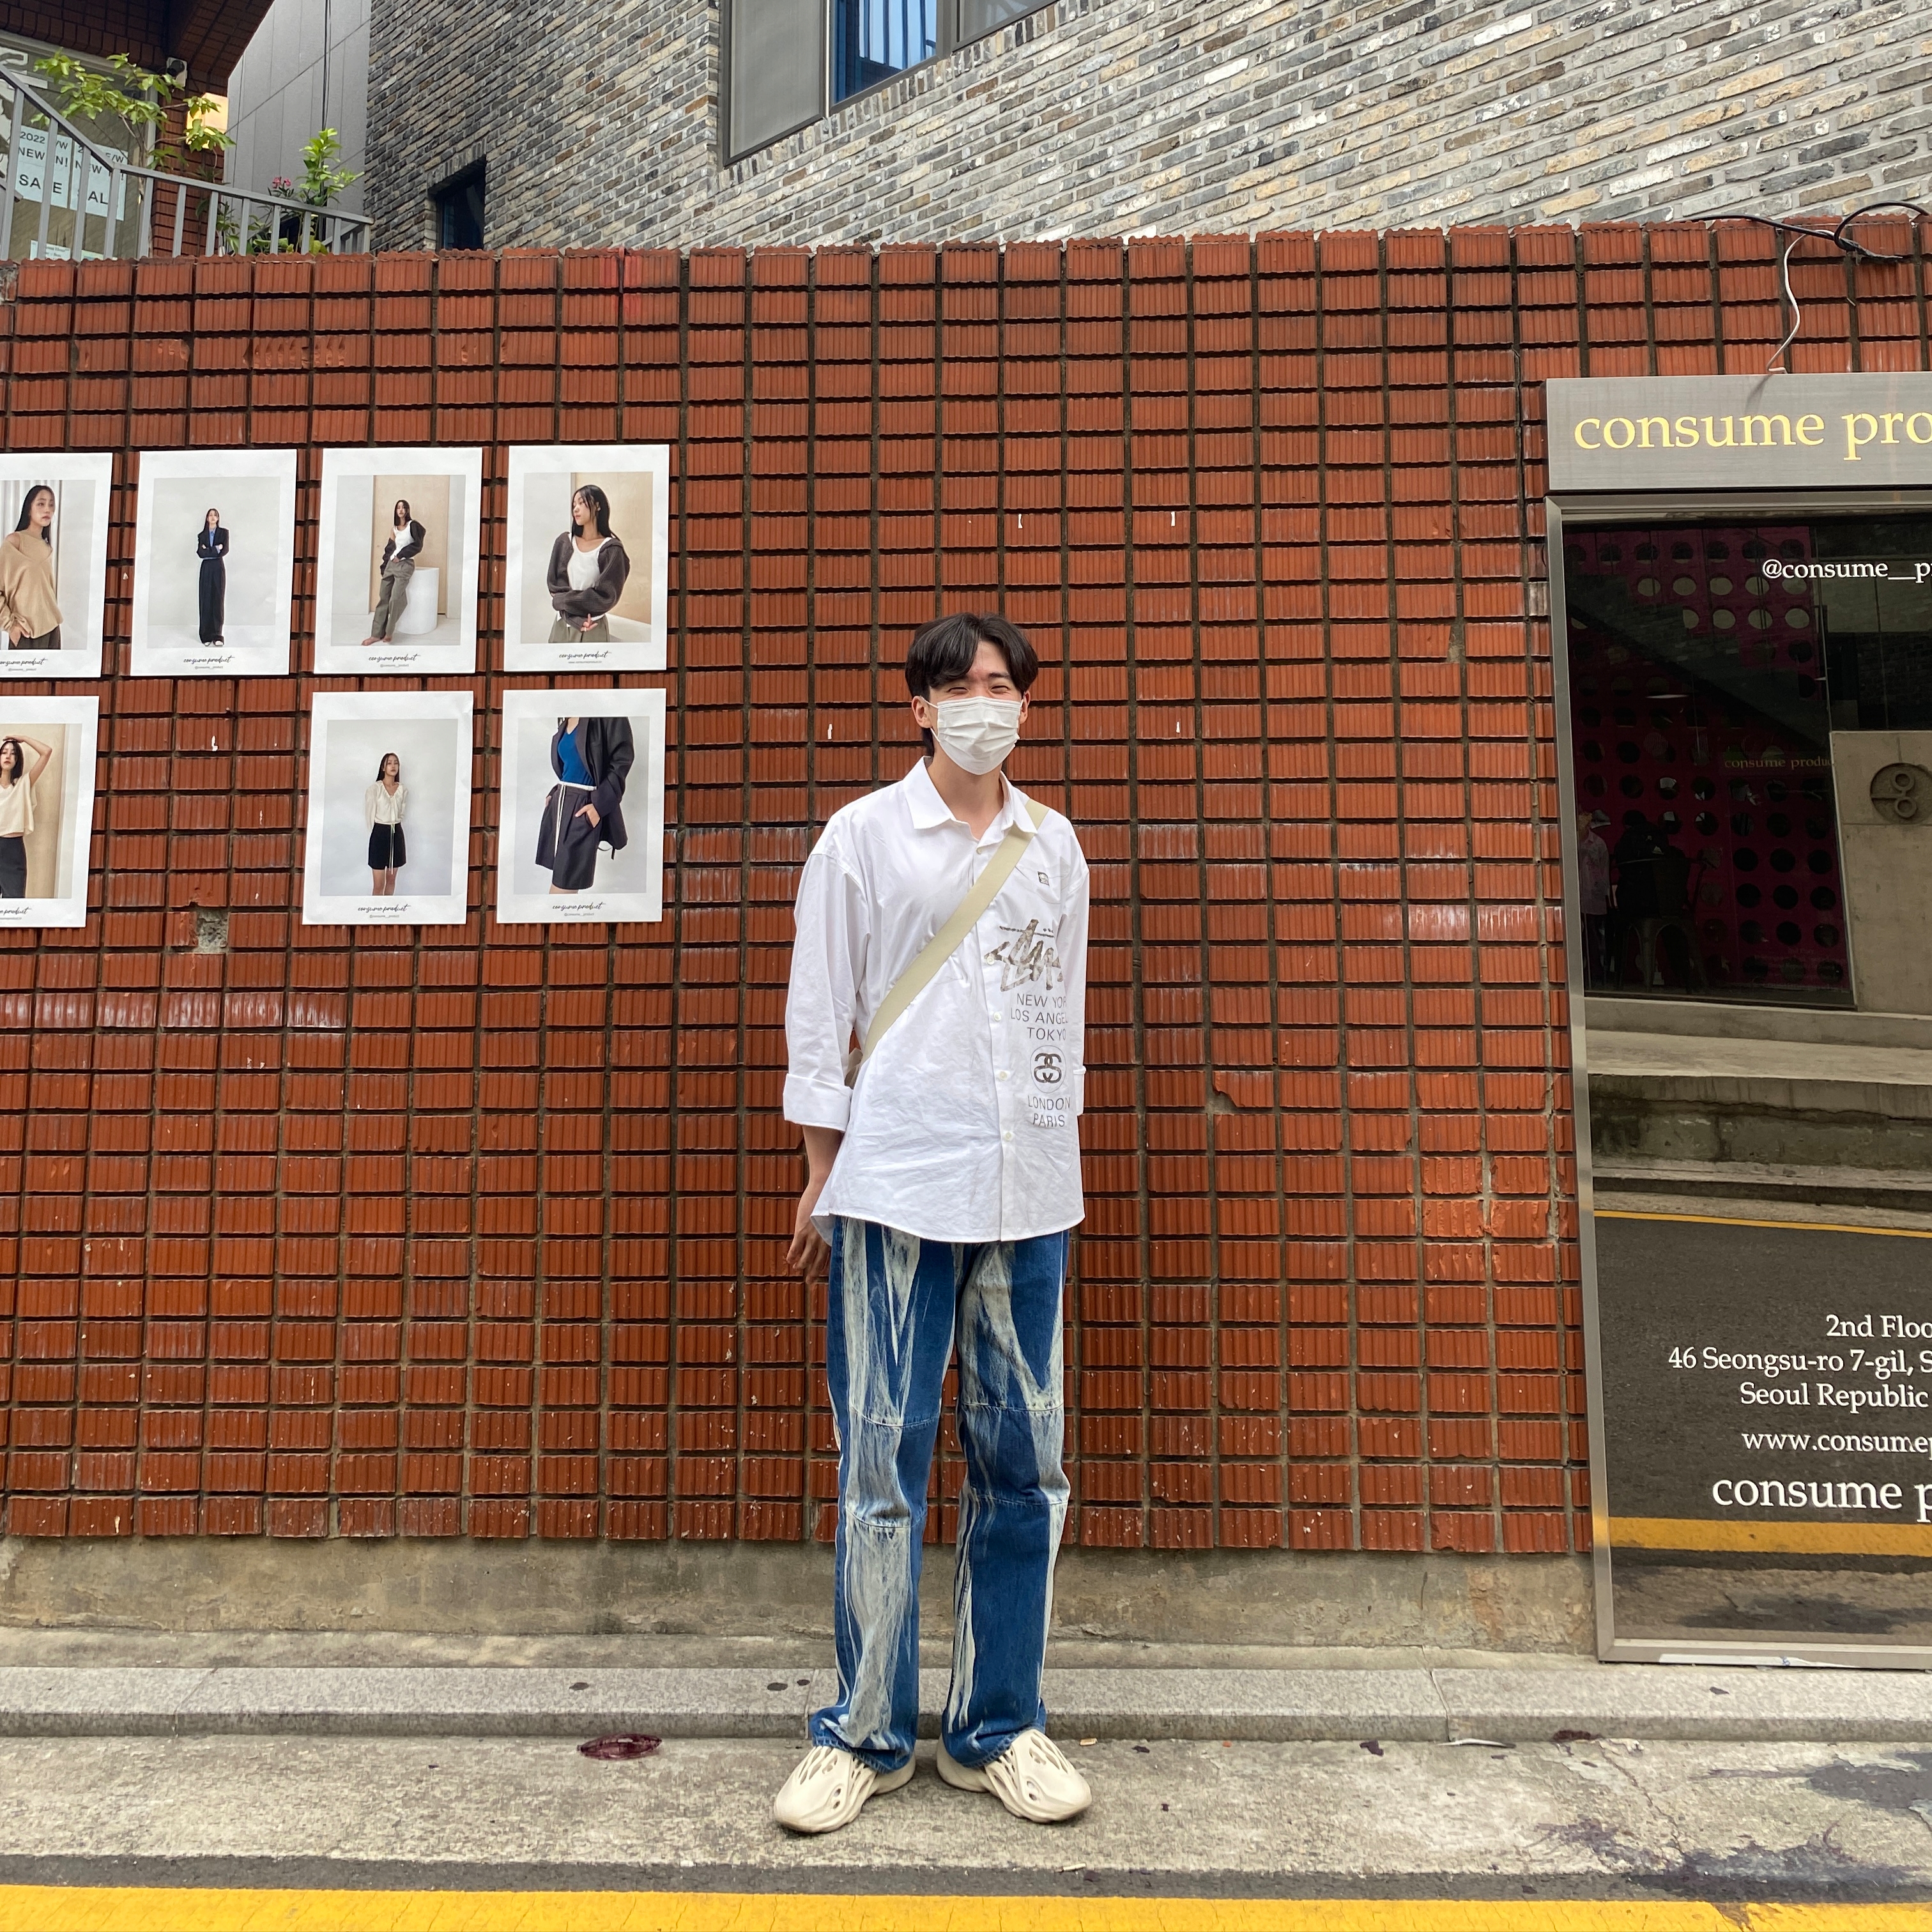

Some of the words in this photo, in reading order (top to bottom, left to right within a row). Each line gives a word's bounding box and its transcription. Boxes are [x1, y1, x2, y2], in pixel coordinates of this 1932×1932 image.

[20, 132, 45, 144] 2022
[19, 147, 45, 160] NEW
[55, 156, 68, 167] N!
[75, 160, 102, 174] NW
[19, 174, 63, 194] SAE
[1574, 413, 1825, 449] consume
[1841, 410, 1932, 461] pro
[1763, 558, 1932, 583] @consume__p
[207, 655, 235, 664] product
[393, 654, 421, 662] product
[583, 650, 612, 659] product
[1725, 758, 1786, 770] consume
[383, 904, 411, 913] product
[578, 901, 606, 911] product
[1016, 993, 1048, 1008] NEW
[1052, 996, 1067, 1008] YOR
[1011, 1008, 1030, 1022] LOS
[1035, 1011, 1068, 1025] ANGEL
[1027, 1027, 1066, 1041] TOKYO
[1027, 1095, 1071, 1110] LONDON
[1032, 1113, 1065, 1128] PARIS
[1825, 1314, 1874, 1337] 2nd
[1880, 1314, 1932, 1338] Floo
[1668, 1346, 1696, 1369] 46
[1703, 1346, 1844, 1378] Seongsu-ro
[1850, 1349, 1914, 1380] 7-gil,
[1740, 1381, 1810, 1406] Seoul
[1816, 1383, 1929, 1414] Republic
[1742, 1433, 1932, 1460] www.consume
[1712, 1479, 1903, 1510] consume
